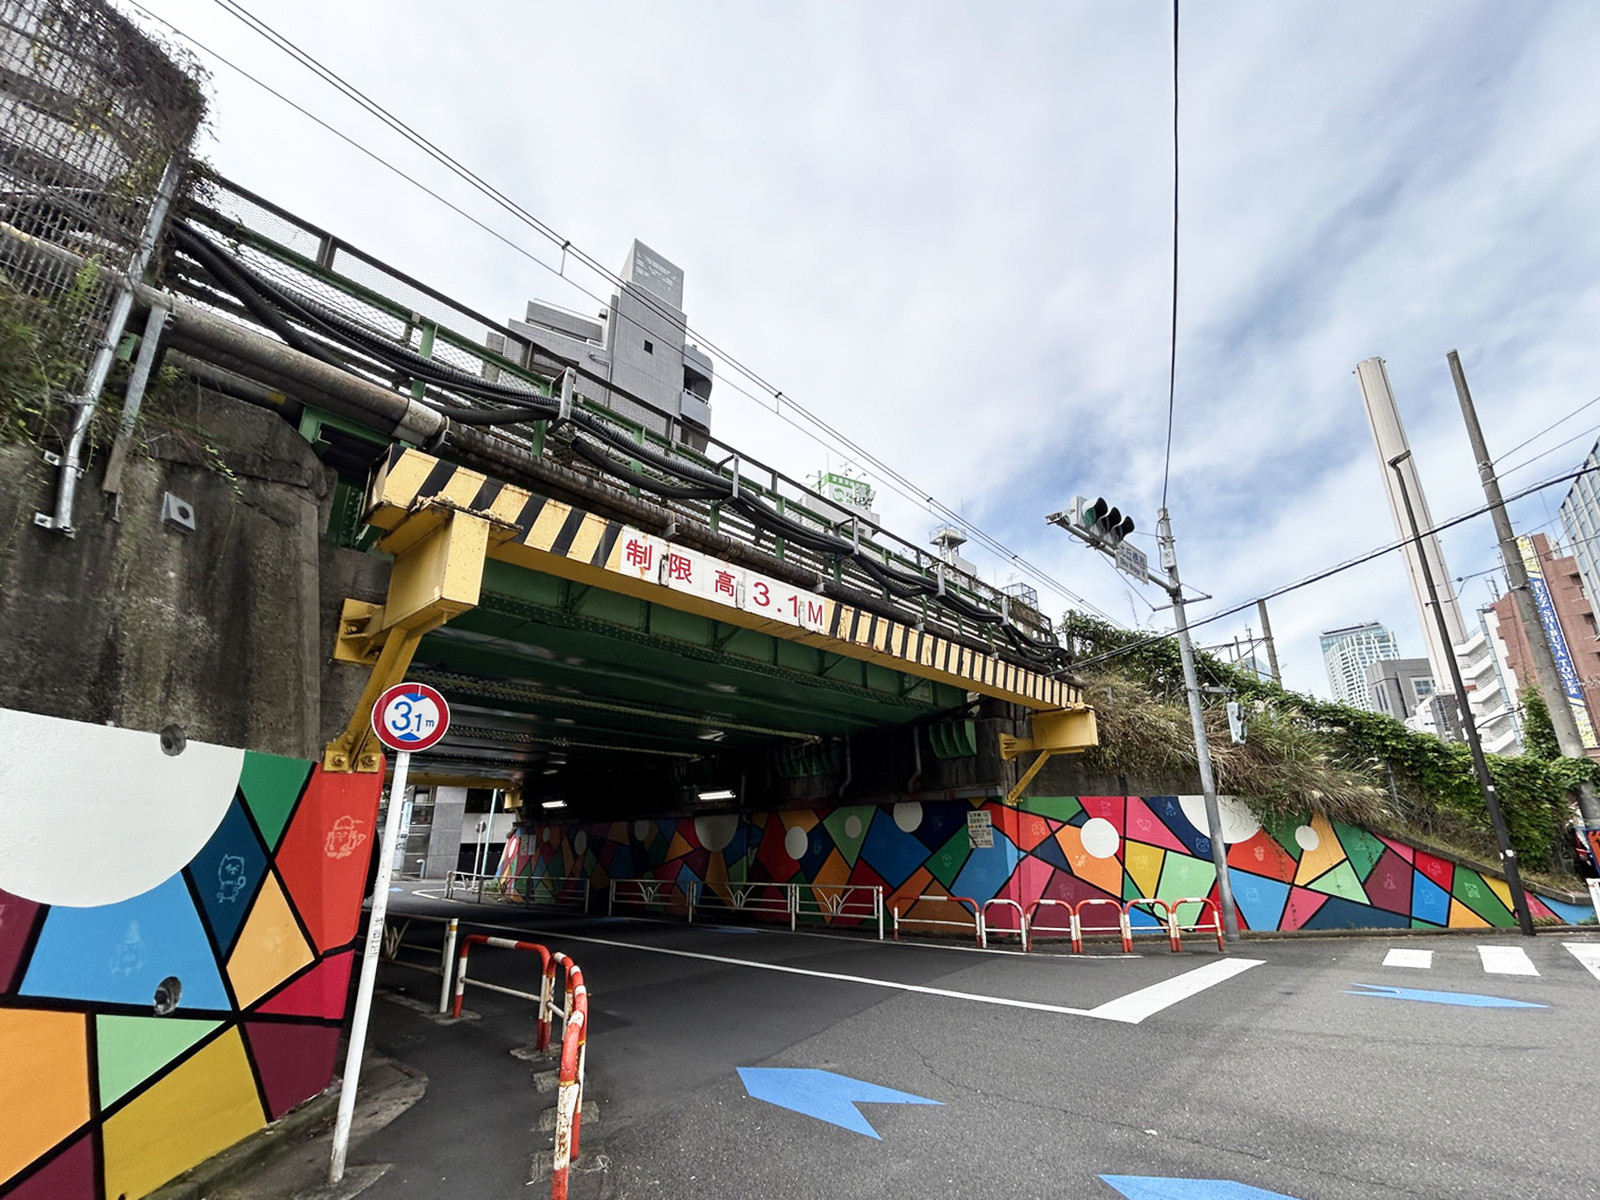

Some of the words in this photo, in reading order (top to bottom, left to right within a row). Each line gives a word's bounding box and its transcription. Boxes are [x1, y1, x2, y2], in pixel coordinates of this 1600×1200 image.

[1533, 581, 1549, 608] BUZZ
[1543, 609, 1566, 657] SHIBUYA
[1559, 659, 1578, 695] TOWER
